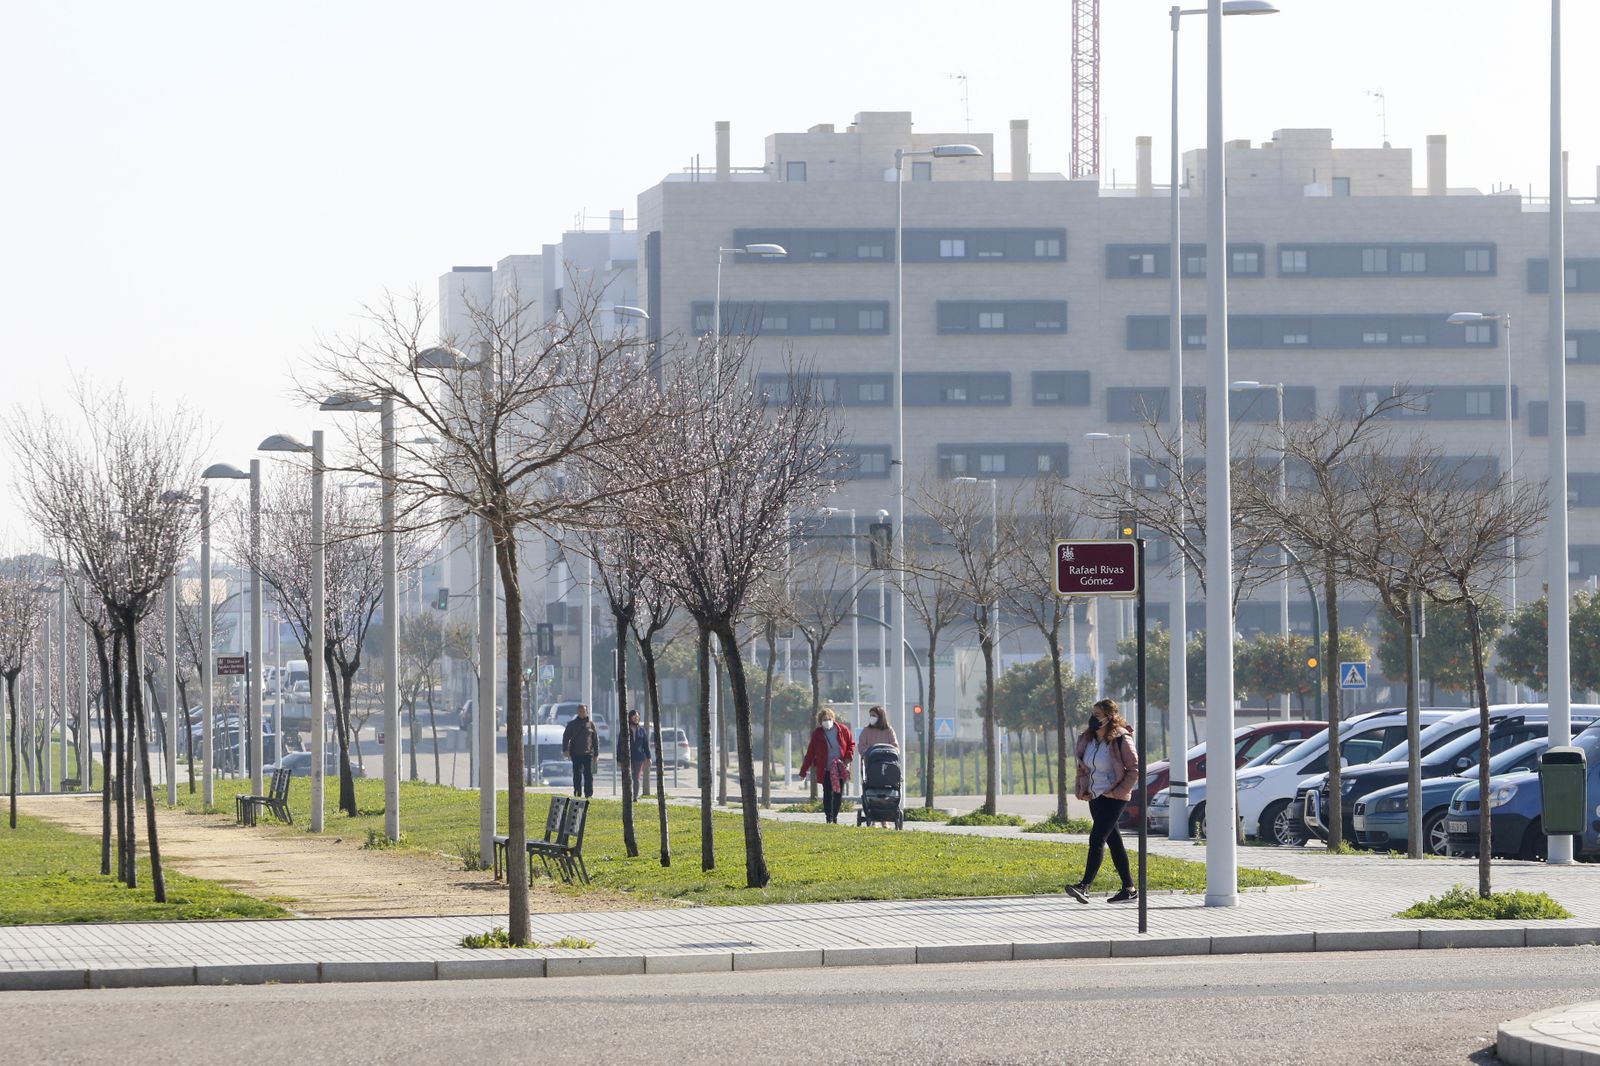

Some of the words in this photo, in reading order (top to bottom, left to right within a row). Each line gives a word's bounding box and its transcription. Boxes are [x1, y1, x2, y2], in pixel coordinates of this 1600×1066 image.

[1069, 565, 1097, 575] Rafael
[1100, 565, 1124, 574] Rivas
[1080, 576, 1113, 585] Gómez
